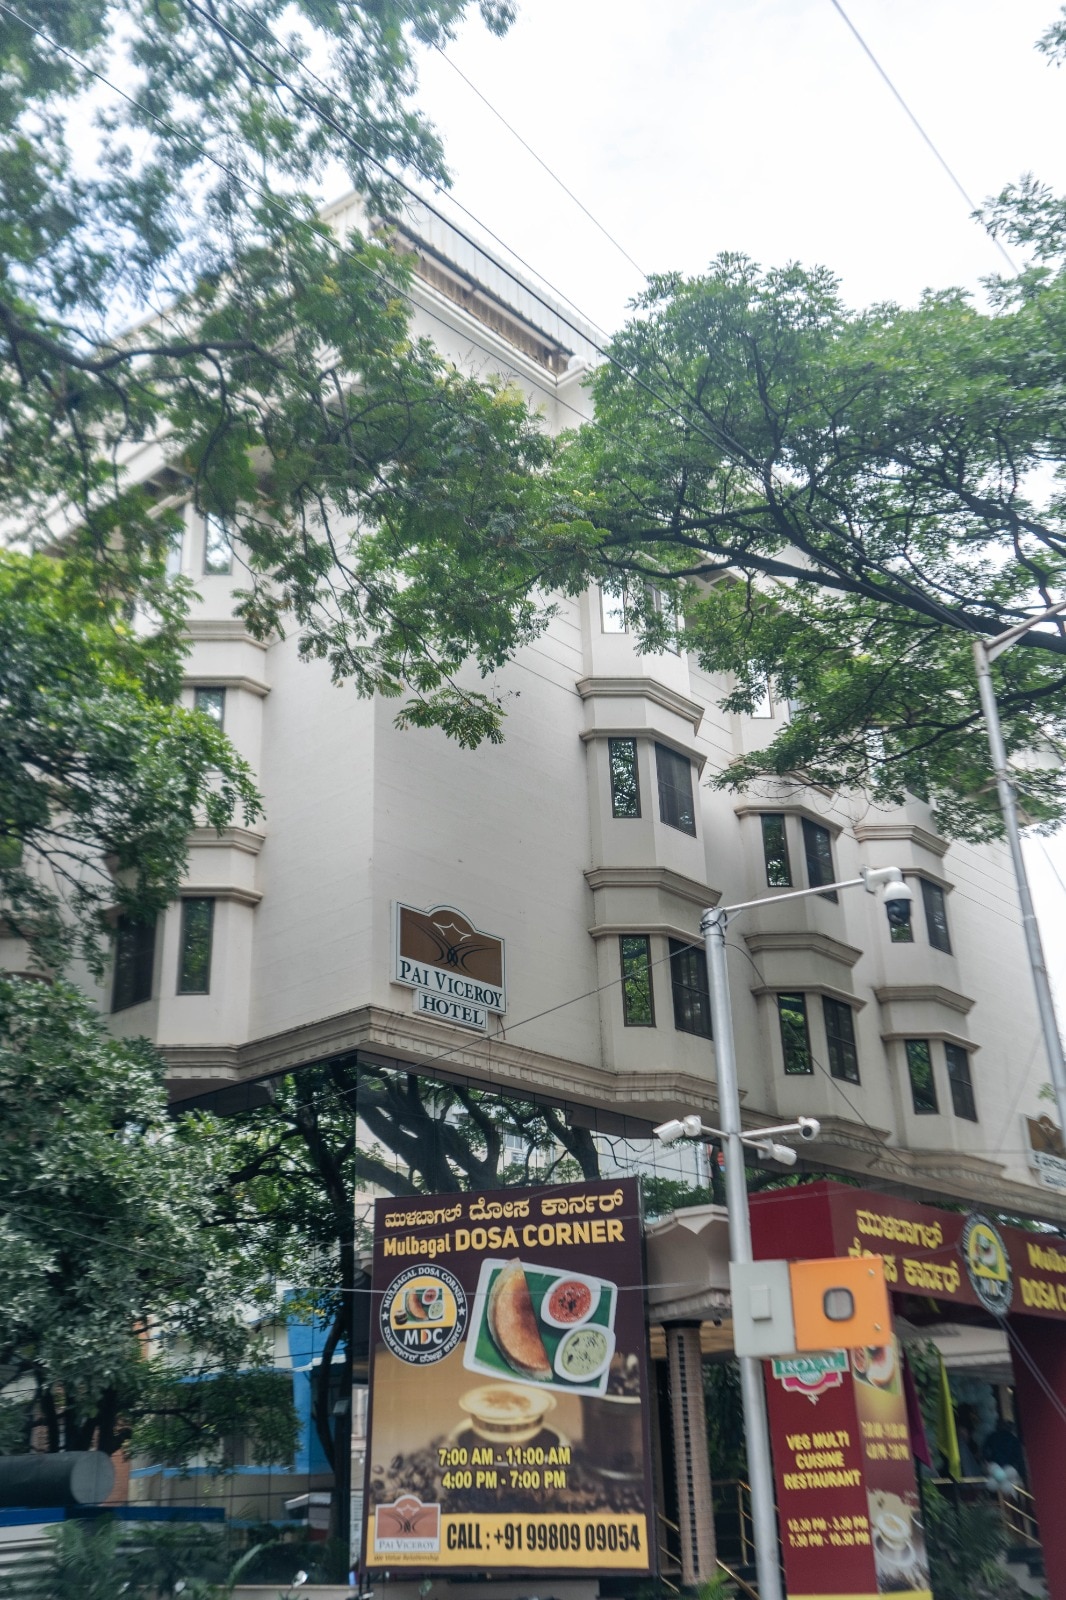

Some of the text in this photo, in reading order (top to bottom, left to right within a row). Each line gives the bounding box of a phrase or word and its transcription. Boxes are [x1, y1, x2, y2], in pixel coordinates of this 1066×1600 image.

[400, 960, 502, 1008] PAI VICEROY
[422, 995, 483, 1025] HOTEL
[384, 1219, 625, 1259] Mulbagal DOSA CORNER
[383, 1267, 464, 1308] MULBAGAL DOSA CORNER
[404, 1328, 443, 1346] MDC
[786, 1433, 811, 1451] VEG
[812, 1430, 850, 1449] MULTI
[439, 1447, 468, 1466] 7:00
[471, 1447, 493, 1465] AM
[506, 1446, 544, 1466] 11:00
[548, 1446, 571, 1465] AM
[796, 1450, 845, 1470] CUISINE
[442, 1470, 472, 1489] 4:00
[476, 1470, 497, 1489] PM
[509, 1470, 540, 1489] 7:00
[544, 1470, 566, 1489] PM
[783, 1469, 861, 1490] RESTAURANT
[446, 1523, 482, 1550] CALL
[494, 1523, 522, 1550] +91
[526, 1523, 581, 1551] 99809
[585, 1523, 640, 1551] 09054
